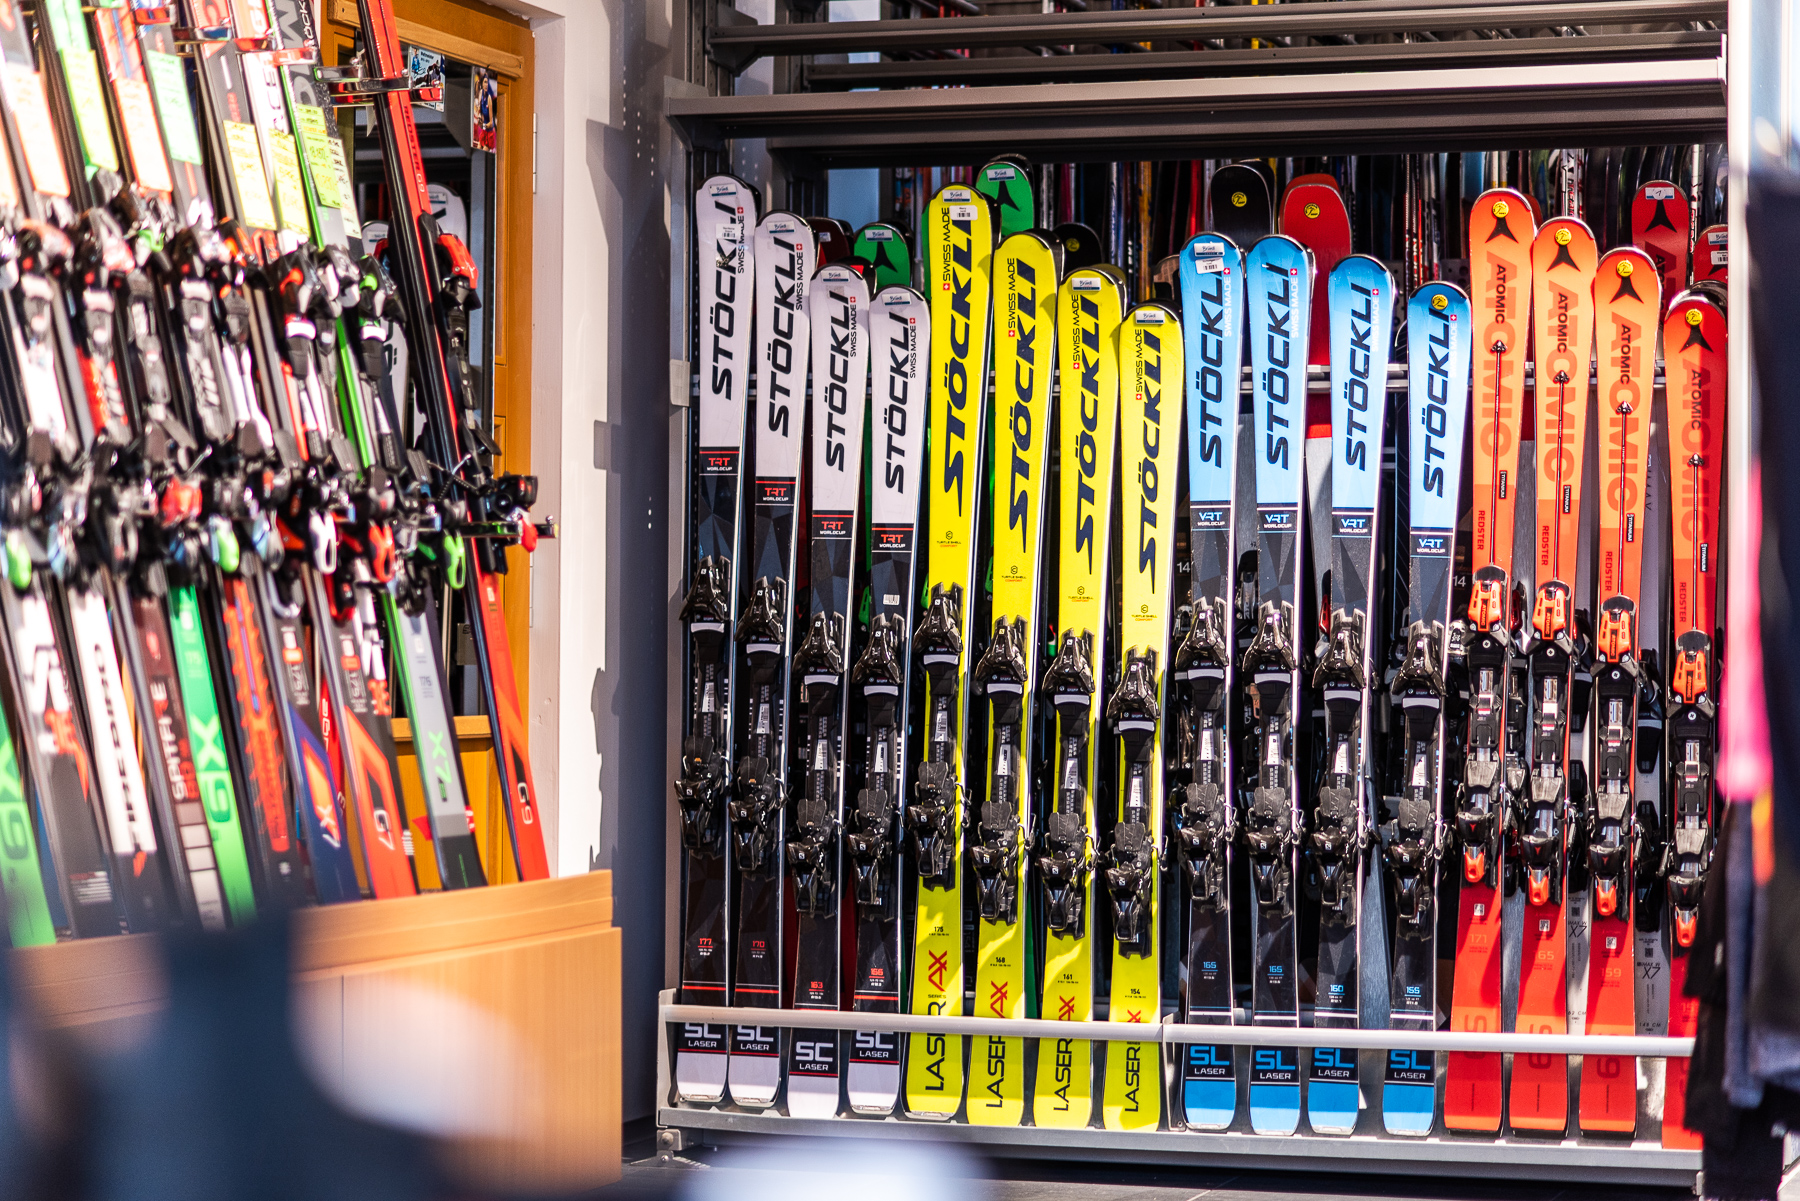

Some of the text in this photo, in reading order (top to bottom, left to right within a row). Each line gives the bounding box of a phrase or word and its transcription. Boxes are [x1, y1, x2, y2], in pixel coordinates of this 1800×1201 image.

[737, 215, 745, 244] MADE
[942, 207, 951, 282] SWISS MADE
[795, 251, 804, 311] SWISS MADE
[1007, 257, 1016, 329] SWISS MADE
[1495, 264, 1507, 325] ATOMIC
[1224, 276, 1233, 338] SWISS MADE
[1291, 276, 1299, 339] SWISS MADE
[1371, 296, 1380, 353] SWISS MADE
[1556, 292, 1568, 353] ATOMIC
[766, 236, 796, 438] STÖCKLI
[849, 304, 857, 357] SWISS MADE
[909, 325, 917, 351] MADE
[1072, 327, 1080, 362] SWISS
[1450, 322, 1458, 350] MADE
[943, 219, 972, 517] STÖCKLI
[1134, 328, 1143, 393] SWISS MADE
[1262, 261, 1290, 470] STÖCKLI
[1480, 250, 1518, 458] ATOMIC
[1620, 323, 1632, 385] ATOMIC
[824, 290, 850, 472] STÖCKLI
[1344, 282, 1372, 472] STÖCKLI
[1543, 279, 1579, 483] ATOMIC
[883, 311, 909, 494] STÖCKLI
[1008, 257, 1036, 554] STÖCKLI
[1421, 307, 1450, 498] STÖCKLI
[1607, 311, 1642, 512] ATOMIC
[1690, 369, 1702, 431] ATOMIC
[1075, 294, 1100, 575] STÖCKLI
[1680, 358, 1711, 542] ATOMIC
[708, 457, 731, 466] TRT
[1137, 329, 1161, 595] STÖCKLI
[764, 487, 787, 496] TRT
[821, 521, 844, 530] TRT
[1198, 512, 1223, 521] VRT
[1265, 514, 1290, 523] VRT
[1341, 518, 1366, 527] VRT
[1477, 510, 1485, 551] REDSTER
[880, 534, 904, 543] TRT
[1419, 538, 1443, 548] VRT
[1541, 525, 1550, 566] REDSTER
[1176, 561, 1191, 573] 14
[1605, 550, 1613, 592] REDSTER
[1679, 582, 1687, 623] REDSTER
[428, 730, 452, 783] X7
[517, 782, 533, 825] G9
[373, 809, 395, 851] G7
[1469, 933, 1487, 943] 171
[1568, 925, 1588, 938] X7
[1537, 950, 1555, 960] 65
[1601, 967, 1622, 977] 159
[1642, 966, 1661, 979] X7
[688, 1040, 717, 1048] LASER
[740, 1043, 770, 1051] LASER
[795, 1042, 834, 1062] SC
[859, 1050, 889, 1058] LASER
[925, 1000, 947, 1091] LASR
[1190, 1046, 1230, 1066] SL
[1255, 1050, 1296, 1070] SL
[1314, 1048, 1354, 1069] SL
[1390, 1050, 1431, 1070] SL
[799, 1063, 829, 1071] LASER
[1053, 1038, 1073, 1112] LASER
[1125, 1045, 1141, 1112] LASER
[1194, 1067, 1226, 1075] LASER
[1259, 1072, 1291, 1080] LASER
[1318, 1069, 1350, 1077] LASER
[1394, 1071, 1426, 1080] LASER
